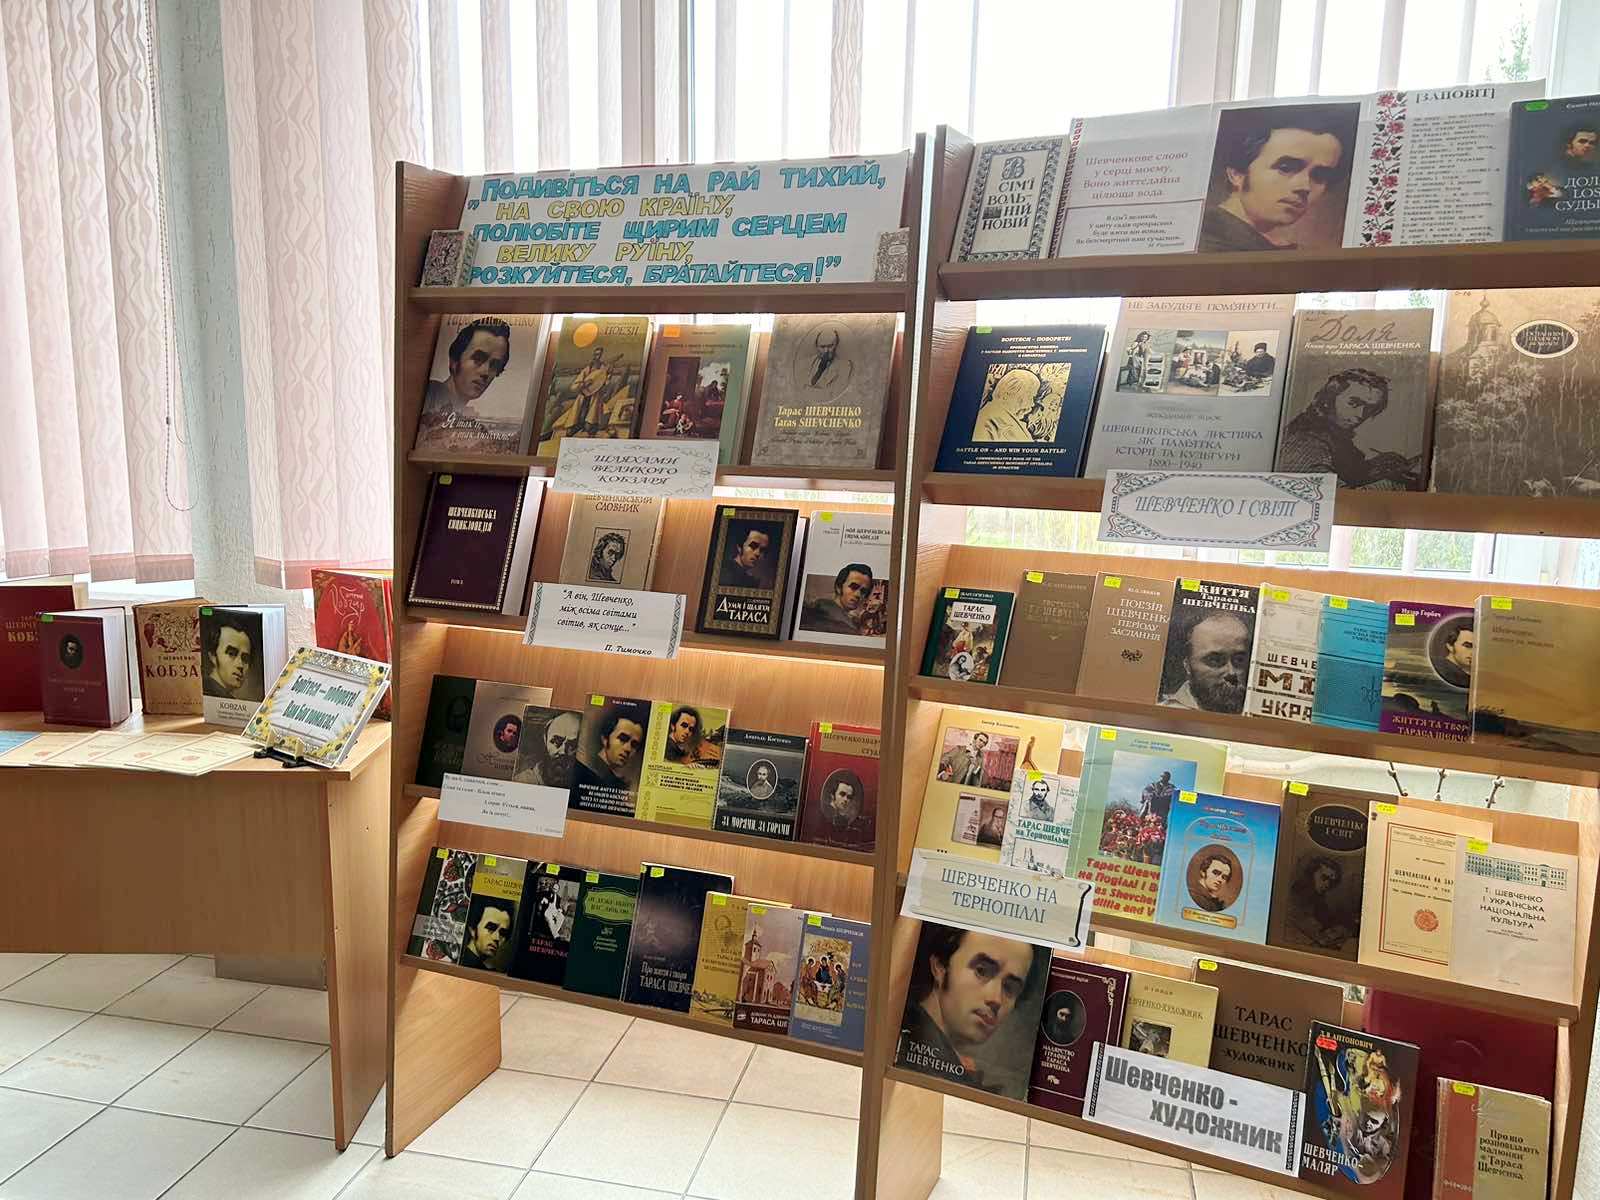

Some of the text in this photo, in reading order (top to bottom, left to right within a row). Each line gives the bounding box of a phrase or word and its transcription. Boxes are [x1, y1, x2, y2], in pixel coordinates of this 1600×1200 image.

[653, 173, 690, 194] НА
[707, 165, 761, 193] РАЙ
[779, 160, 888, 190] ТИХИЙ,
[1564, 176, 1600, 189] ДОЛ
[495, 193, 735, 221] НА СВОЮ КРАЇНУ,
[473, 212, 848, 244] ПОЛЮБІТЕ ЩИРИМ СЕРЦЕМ
[982, 215, 1028, 230] НОВІЙ
[496, 237, 694, 264] ВЕЛИКУ РУЇНУ,
[804, 406, 861, 417] ШЕВЧЕНКО
[774, 417, 862, 428] Taras SHEVCHENKO
[593, 454, 681, 465] ШЛЯХАМИ
[591, 464, 678, 475] ВЕЛИКОГО
[597, 475, 670, 486] КОБЗАРЯ
[595, 502, 640, 513] СЛОВНИК
[1135, 495, 1235, 518] ШЕВЧЕНКО
[1248, 500, 1297, 518] СВІТ
[591, 592, 634, 606] Шевченко,
[1182, 597, 1257, 614] ШЕВЧЕНКА
[1200, 592, 1240, 604] Тараса
[559, 604, 638, 619] між всіма світами
[727, 609, 769, 623] ТАРАСА
[953, 611, 991, 621] ШЕВЧЕНКО
[963, 605, 984, 613] ТАРАС
[557, 617, 585, 629] світив,
[587, 622, 600, 631] як
[604, 644, 652, 656] П. Тимочко
[145, 664, 199, 678] КОБЗА
[219, 702, 248, 711] KOBZAR
[1017, 819, 1042, 831] ТАРАС
[1087, 858, 1120, 872] Тарас
[941, 868, 1058, 905] ШЕВЧЕНКО НА
[1109, 888, 1157, 906] Shevche
[1495, 888, 1544, 903] ШЕВЧЕНКО
[952, 891, 1046, 924] ТЕРНОПІЛЛІ
[1122, 904, 1145, 915] and
[1489, 896, 1545, 912] УКРАЇНСЬКА
[1480, 904, 1546, 922] НАЦІОНАЛЬНА
[1491, 915, 1535, 930] КУЛЬТУРА
[640, 975, 666, 991] ТАРАСА
[1130, 997, 1203, 1020] ЕВЧЕНКО-ХУДОЖНИК
[751, 1016, 776, 1026] ТАРАСА
[1234, 1006, 1293, 1031] ТАРАС
[1214, 1023, 1308, 1058] ШЕВЧЕНКО
[909, 1041, 939, 1058] ТАРАС
[906, 1052, 965, 1076] ШЕВЧЕНКО
[1150, 1097, 1284, 1154] художник
[1490, 1129, 1524, 1143] Про що
[1304, 1142, 1364, 1169] ШЕВЧЕНКО-
[1487, 1154, 1523, 1169] Тараса
[1302, 1155, 1338, 1176] МАЛЯР
[1478, 1161, 1524, 1180] Шевченка
